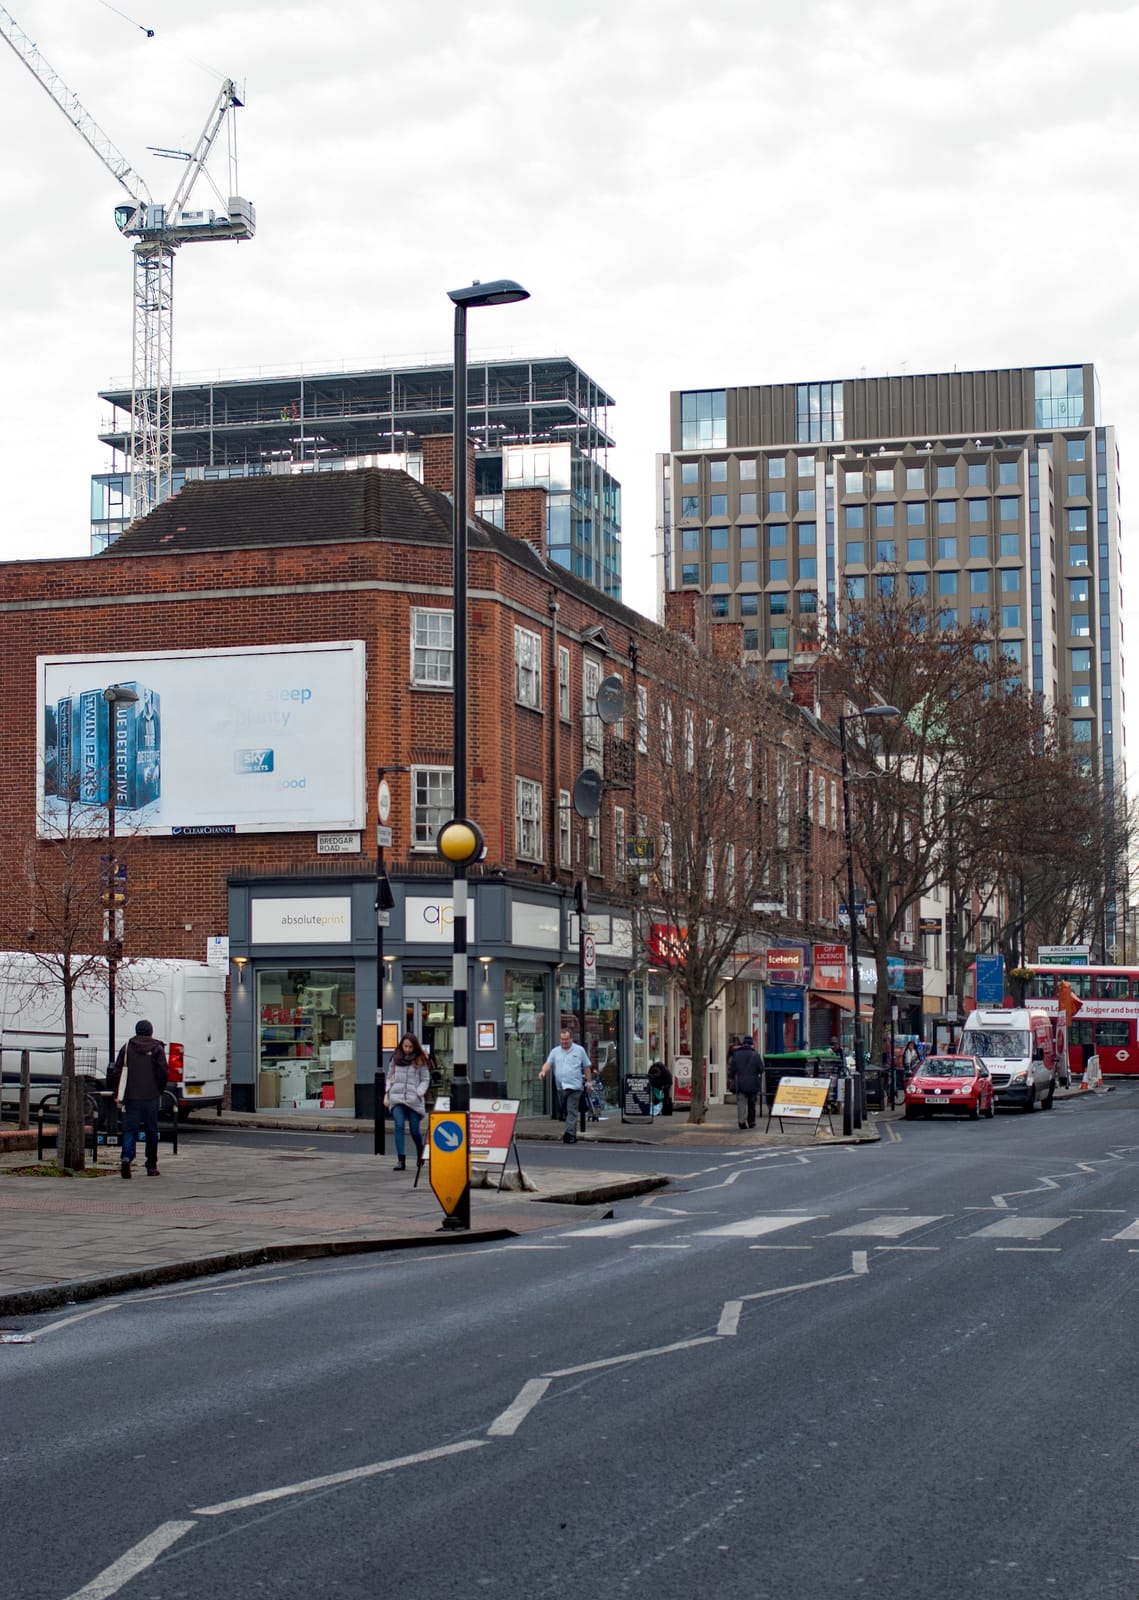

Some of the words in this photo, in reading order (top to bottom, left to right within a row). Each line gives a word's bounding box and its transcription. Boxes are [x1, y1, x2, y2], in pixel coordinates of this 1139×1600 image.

[85, 694, 97, 739] TWIN
[116, 730, 128, 801] DETECTIVE
[319, 837, 354, 845] BREDGAR
[281, 914, 344, 927] absoluteprint
[768, 955, 799, 964] Iceland
[1086, 1006, 1109, 1014] bigger
